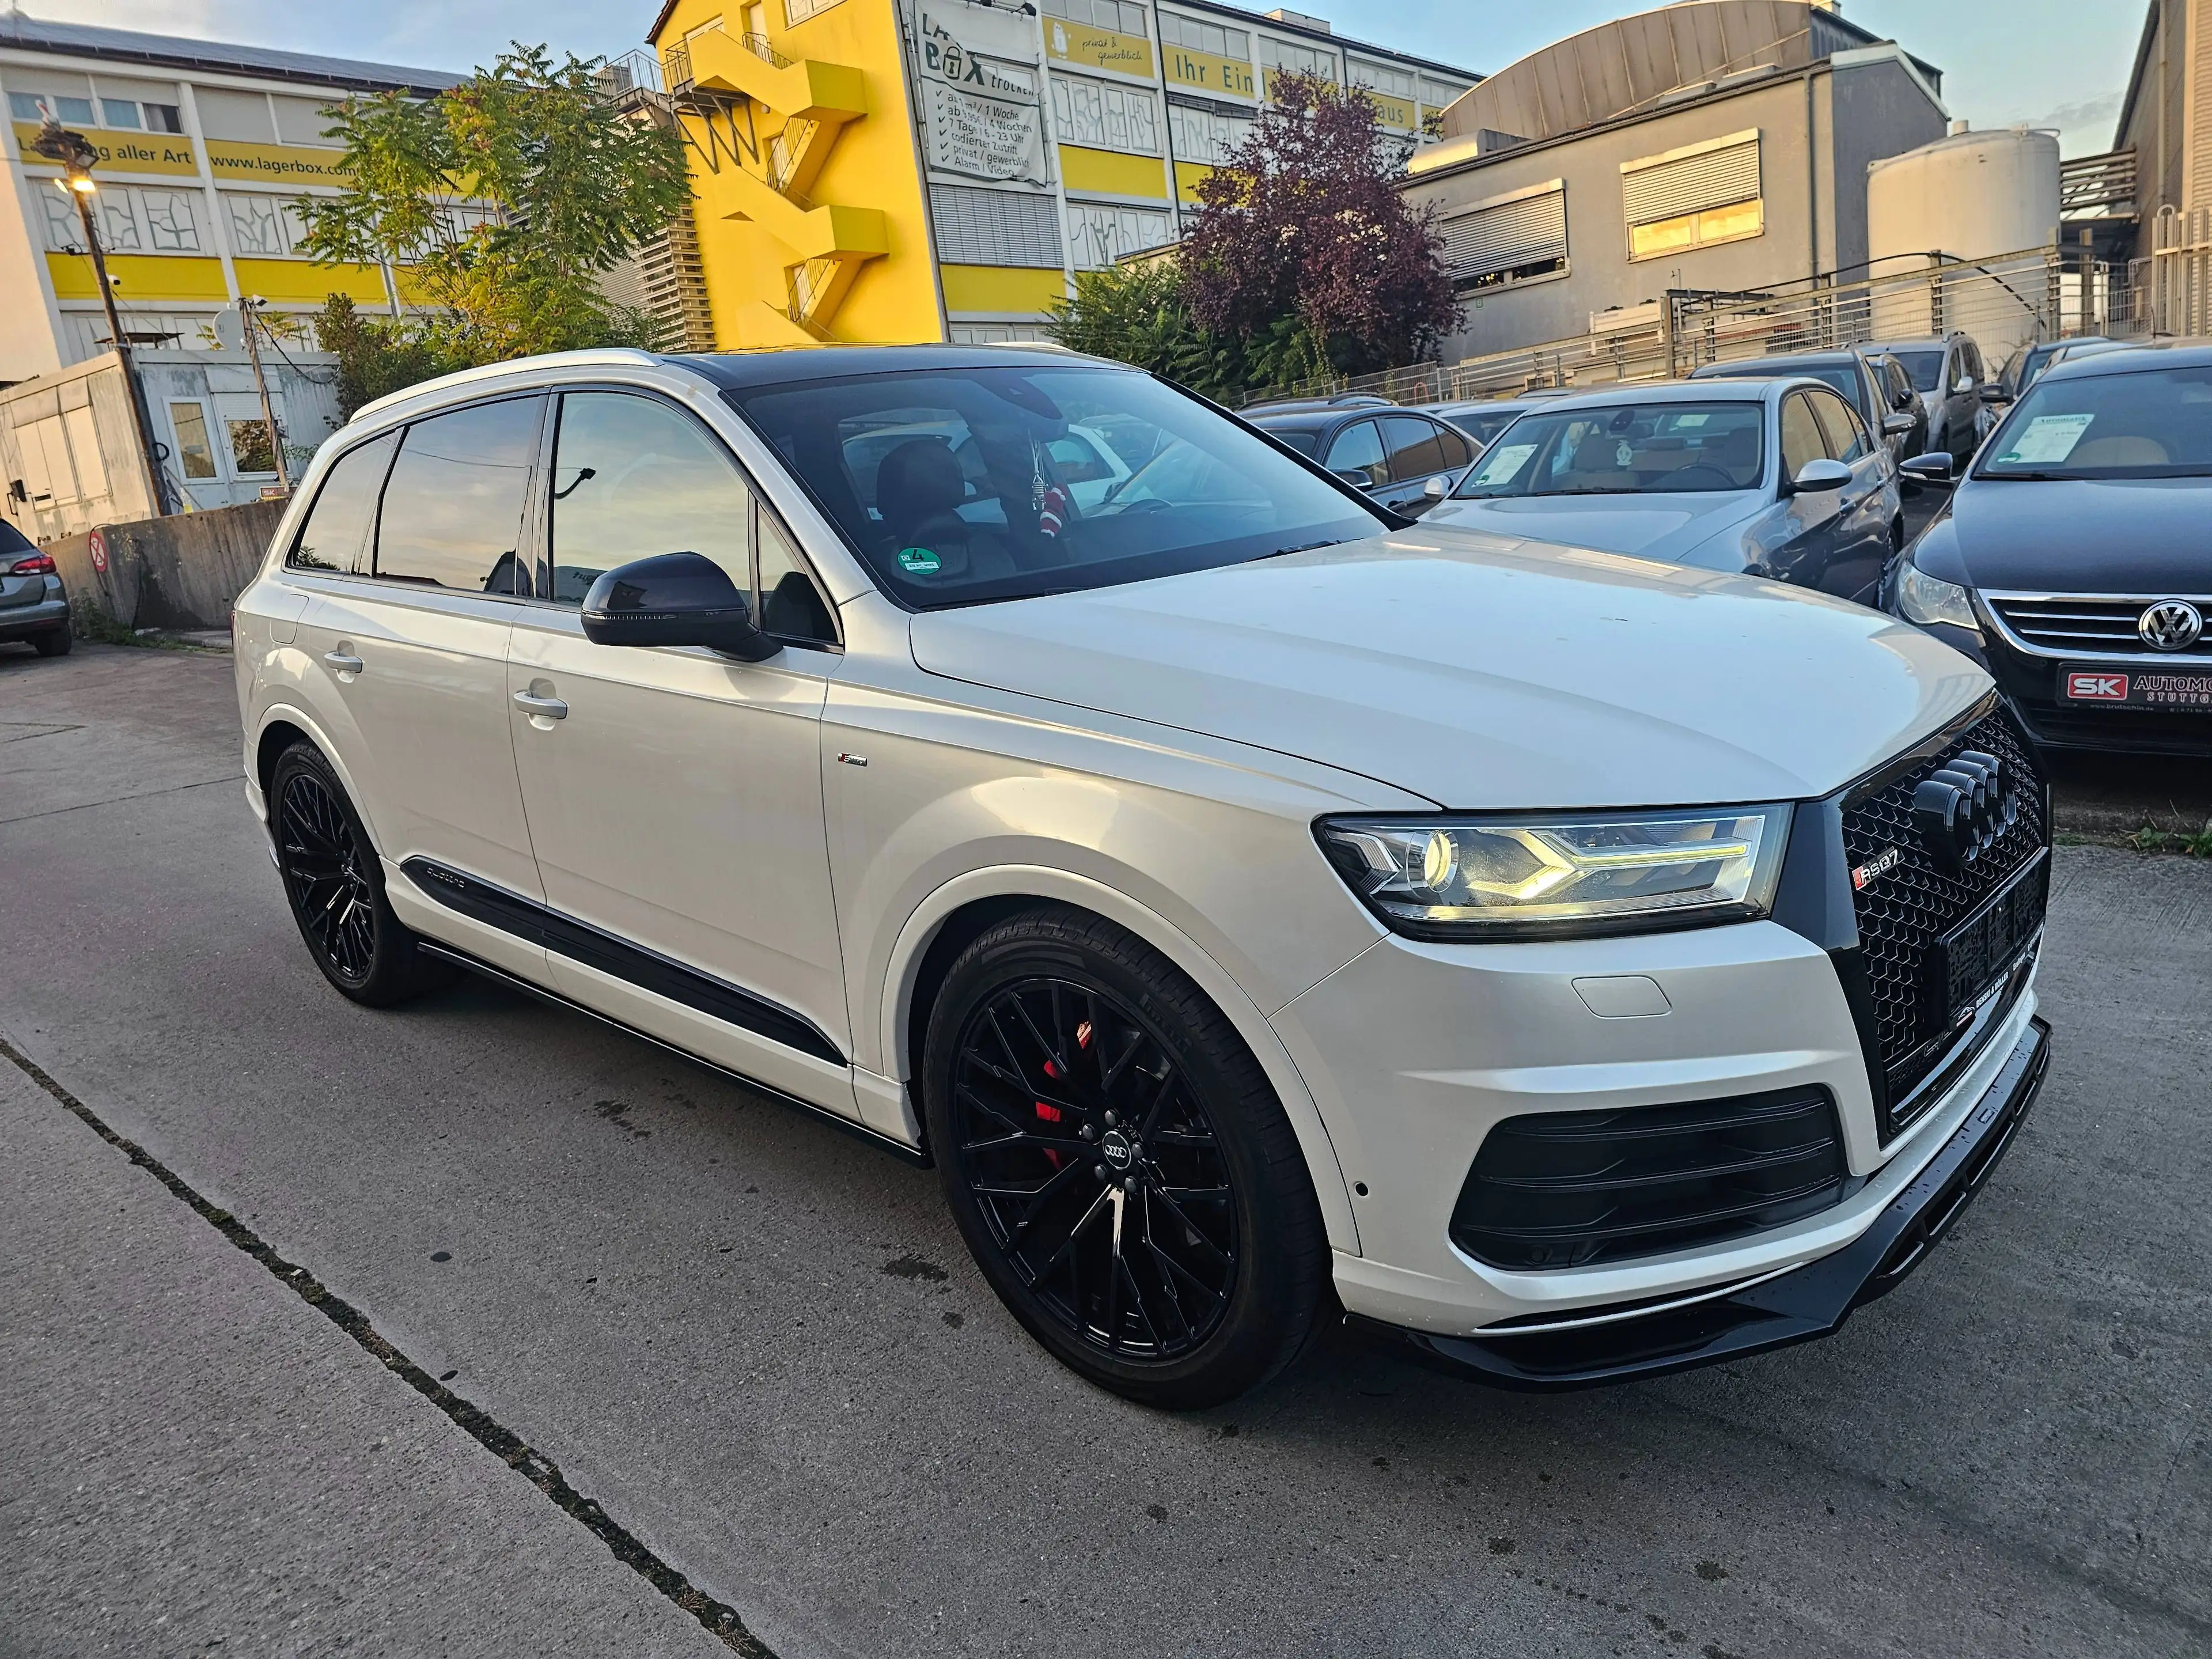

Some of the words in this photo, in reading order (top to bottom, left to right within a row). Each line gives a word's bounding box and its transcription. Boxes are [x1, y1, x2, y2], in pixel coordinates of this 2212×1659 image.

[1082, 38, 1107, 51] privat
[1098, 50, 1143, 66] gewerblich
[1176, 55, 1206, 82] Ihr
[948, 105, 960, 116] ab
[990, 119, 995, 128] 4
[997, 120, 1032, 132] Wochen
[986, 105, 990, 115] 1
[994, 106, 1020, 121] Woche
[949, 118, 954, 127] 7
[997, 132, 1008, 141] 23
[1010, 134, 1024, 143] Uhr
[952, 132, 990, 149] codierter
[993, 141, 1018, 155] Zutritt
[117, 145, 156, 161] aller
[164, 149, 192, 164] Art
[953, 145, 978, 160] privat
[987, 153, 1030, 168] gewerblich
[210, 156, 357, 177] www.lagerbox.com
[955, 156, 980, 171] Alarm
[987, 164, 1014, 176] Video
[912, 548, 925, 561] 4
[2073, 677, 2122, 696] SK
[2147, 692, 2212, 704] STUTTG
[1860, 849, 1898, 885] RSQ7
[427, 868, 465, 888] quattro
